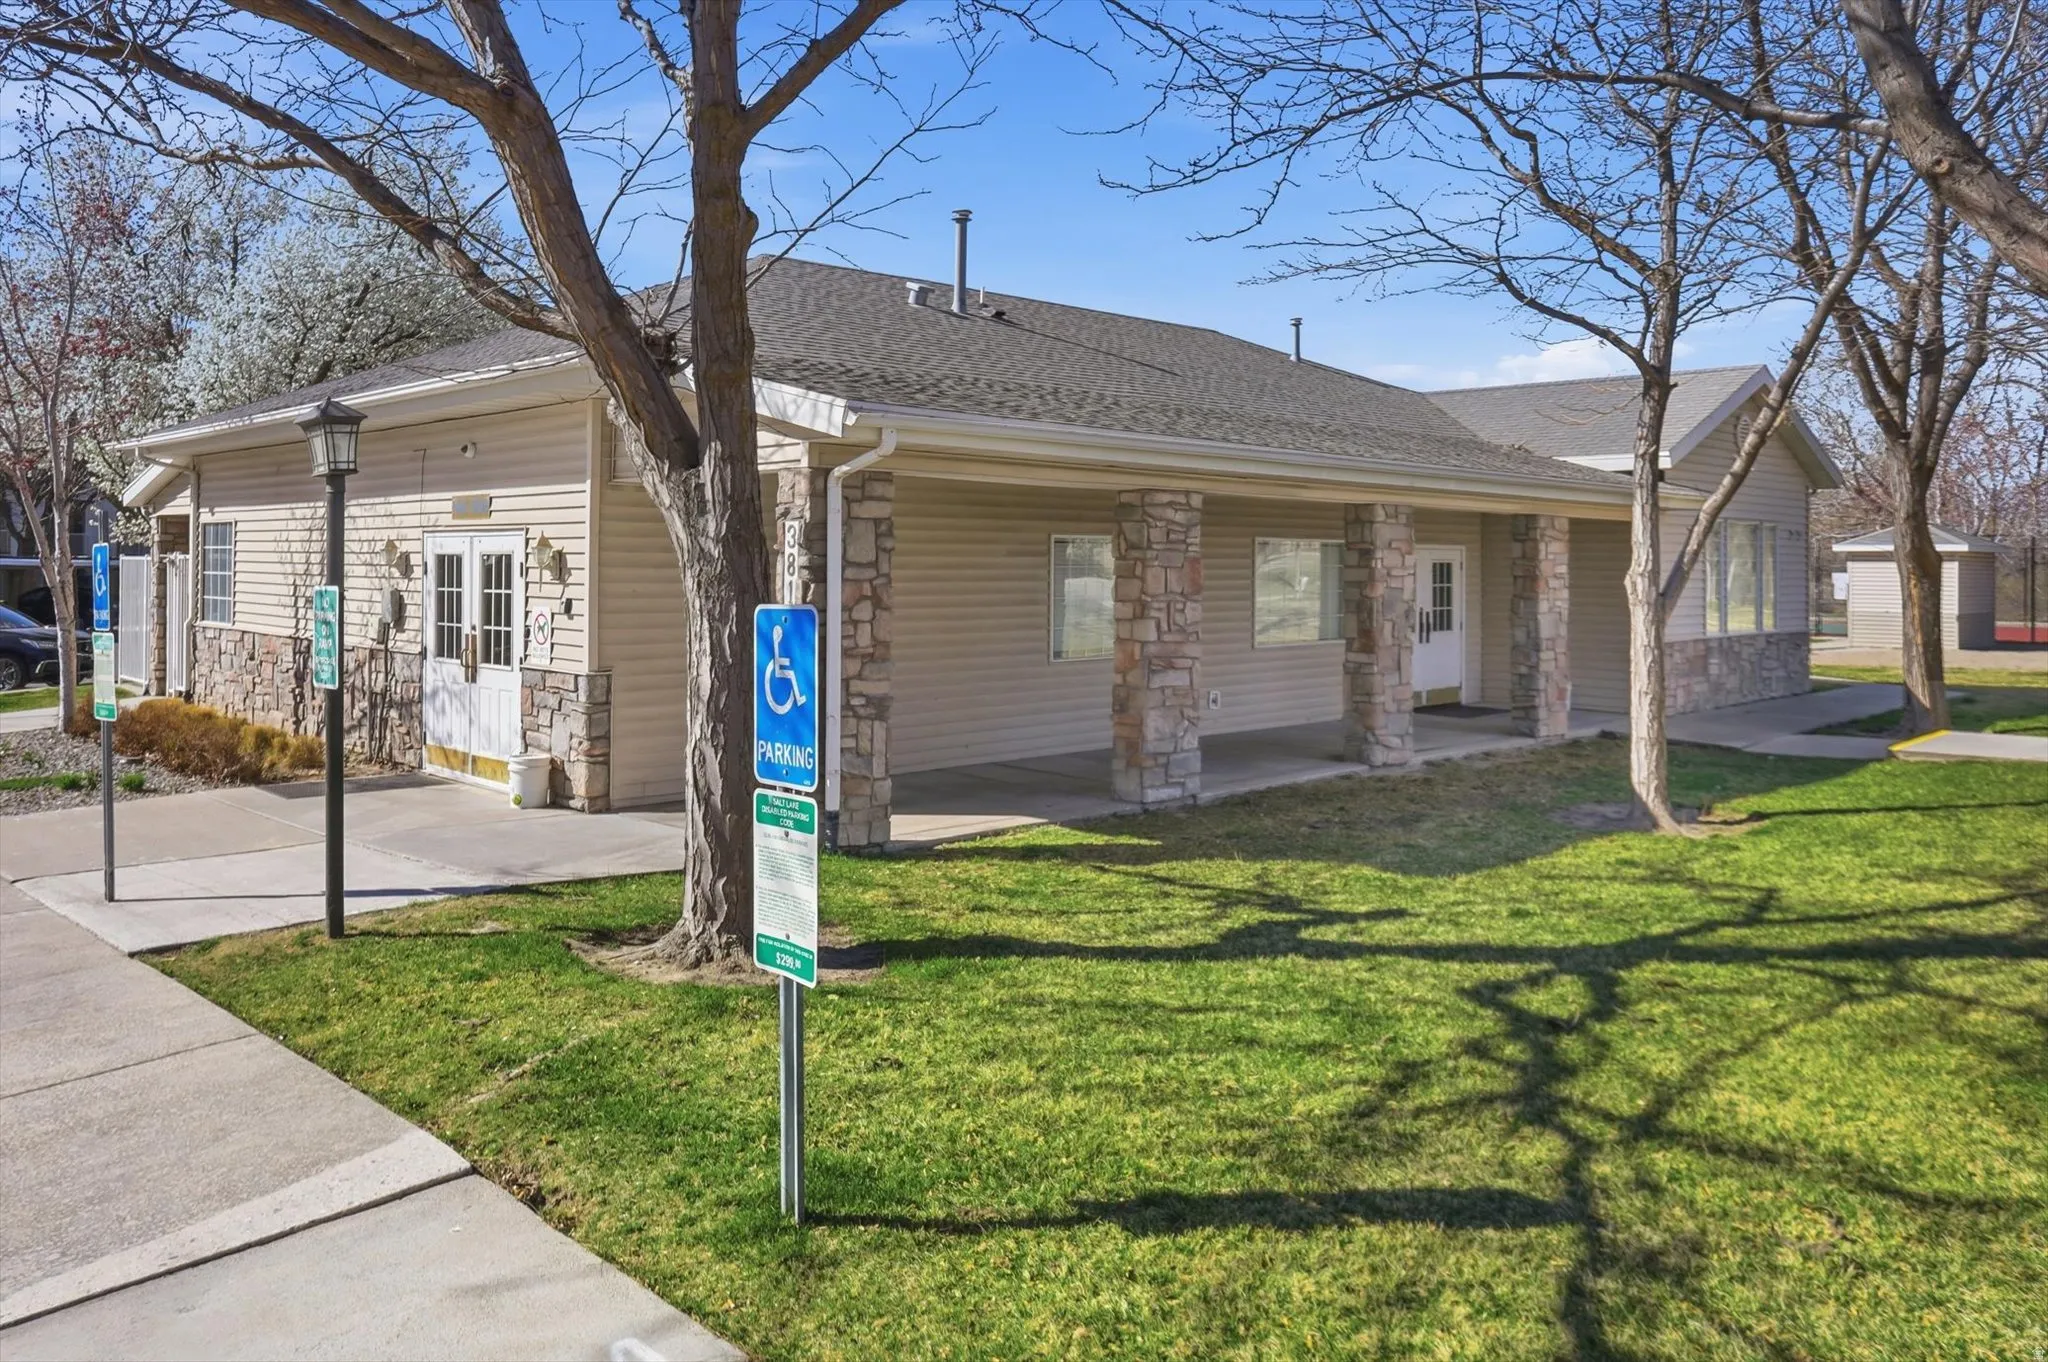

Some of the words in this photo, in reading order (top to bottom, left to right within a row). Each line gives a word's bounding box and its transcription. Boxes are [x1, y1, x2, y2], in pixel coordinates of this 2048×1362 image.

[758, 740, 814, 770] PARKING
[772, 797, 785, 807] SALT
[761, 805, 788, 817] DISABLED
[779, 818, 795, 829] CODE
